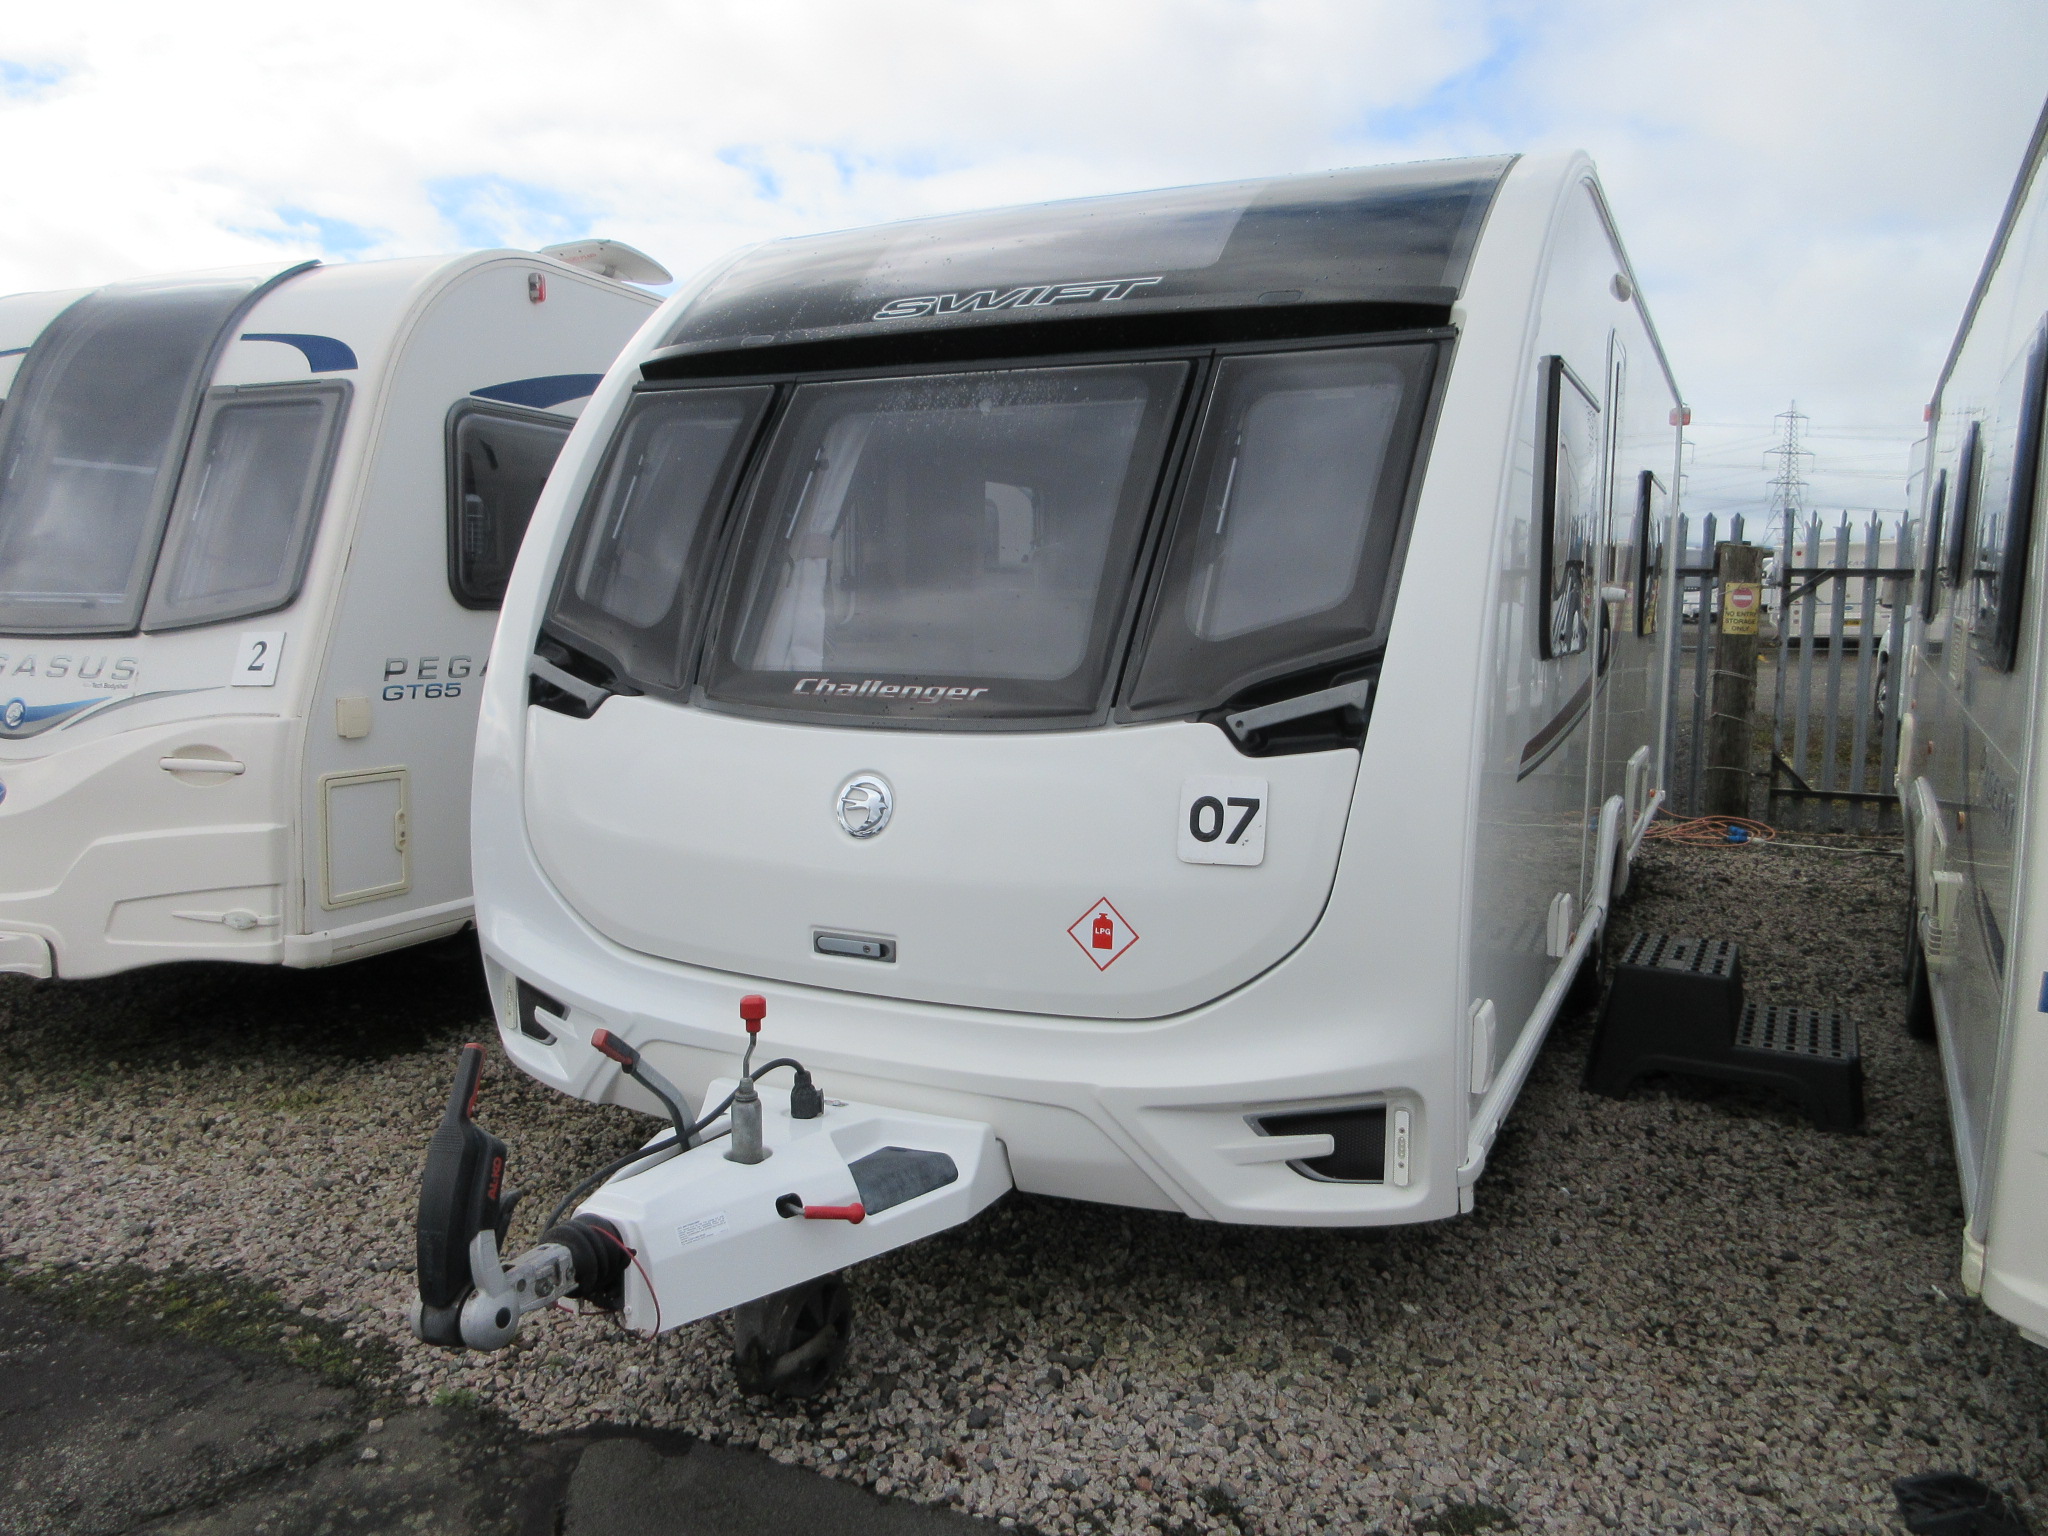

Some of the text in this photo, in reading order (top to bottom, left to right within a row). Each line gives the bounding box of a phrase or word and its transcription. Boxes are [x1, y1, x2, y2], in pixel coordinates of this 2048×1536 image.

[873, 276, 1163, 320] SWIFT
[247, 640, 268, 671] 2
[382, 682, 462, 702] GT65
[792, 677, 989, 704] Challenger
[1189, 795, 1260, 844] 07
[1094, 927, 1111, 936] LPG
